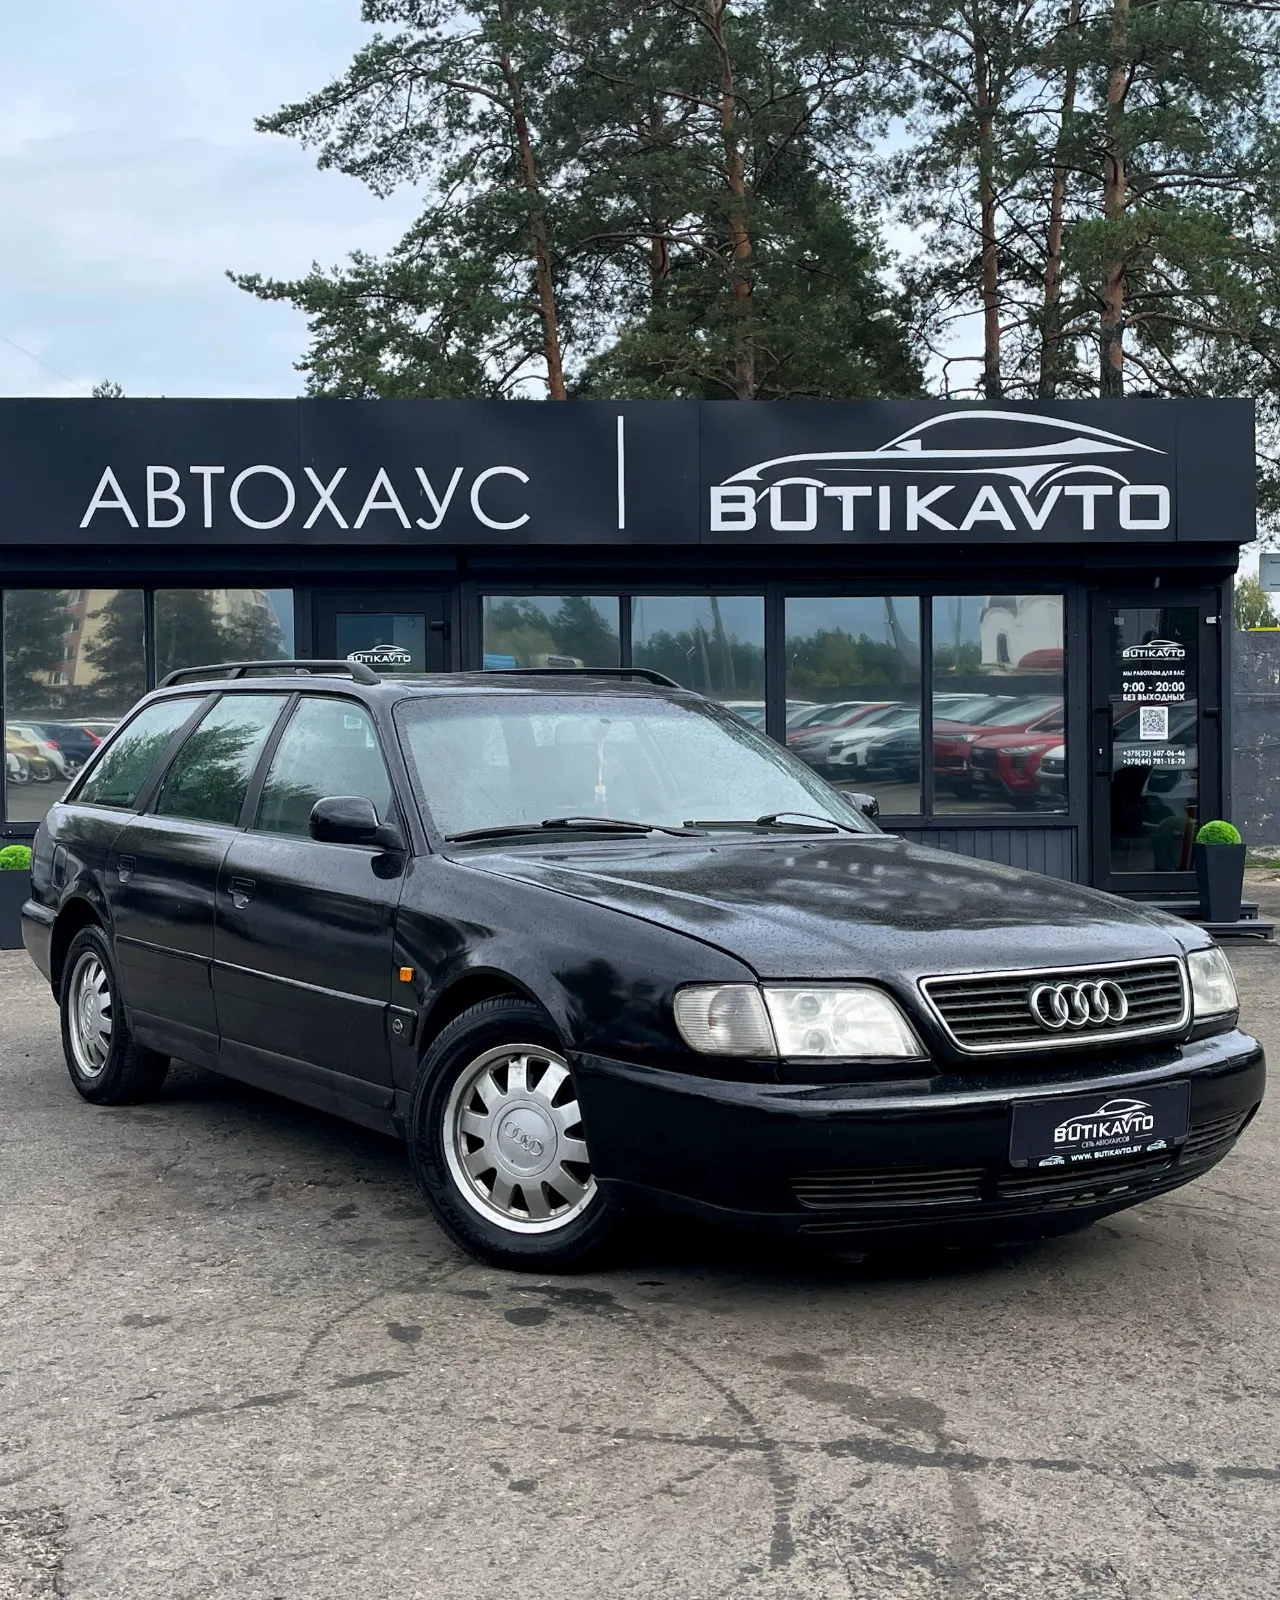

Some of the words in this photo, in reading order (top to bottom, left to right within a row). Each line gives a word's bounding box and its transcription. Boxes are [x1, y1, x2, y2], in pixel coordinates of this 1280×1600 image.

[79, 465, 531, 531] АВТОХАУС
[710, 484, 1171, 532] BUTIKAVTO
[1122, 649, 1185, 657] BUTIKAVTO
[1122, 682, 1146, 692] 9:00
[1155, 682, 1185, 692] 20:00
[1122, 693, 1136, 701] БЕЗ
[1137, 693, 1186, 701] ВЫХОДНЫХ
[1122, 749, 1152, 758] +375(33)
[1122, 757, 1152, 766] +375(44)
[1054, 1115, 1154, 1143] BUTIKAVTO
